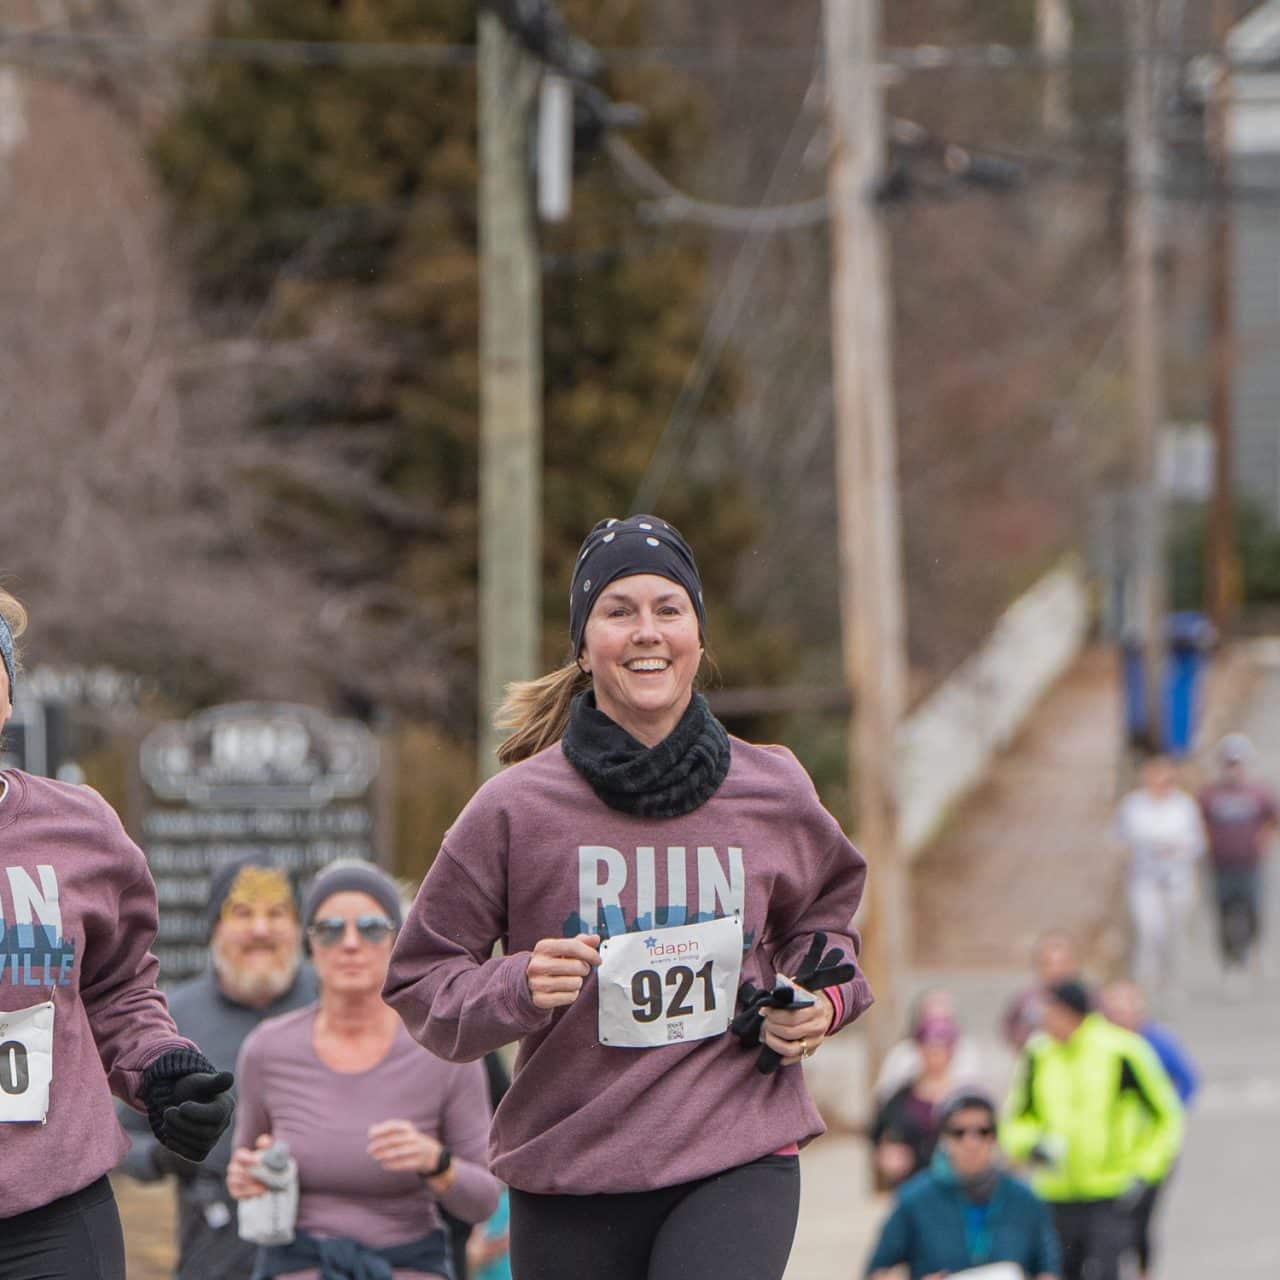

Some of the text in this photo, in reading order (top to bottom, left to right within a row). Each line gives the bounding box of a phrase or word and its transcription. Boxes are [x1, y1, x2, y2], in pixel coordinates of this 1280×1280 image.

[578, 845, 745, 938] RUN
[649, 938, 699, 957] idaph
[631, 959, 717, 1024] 921
